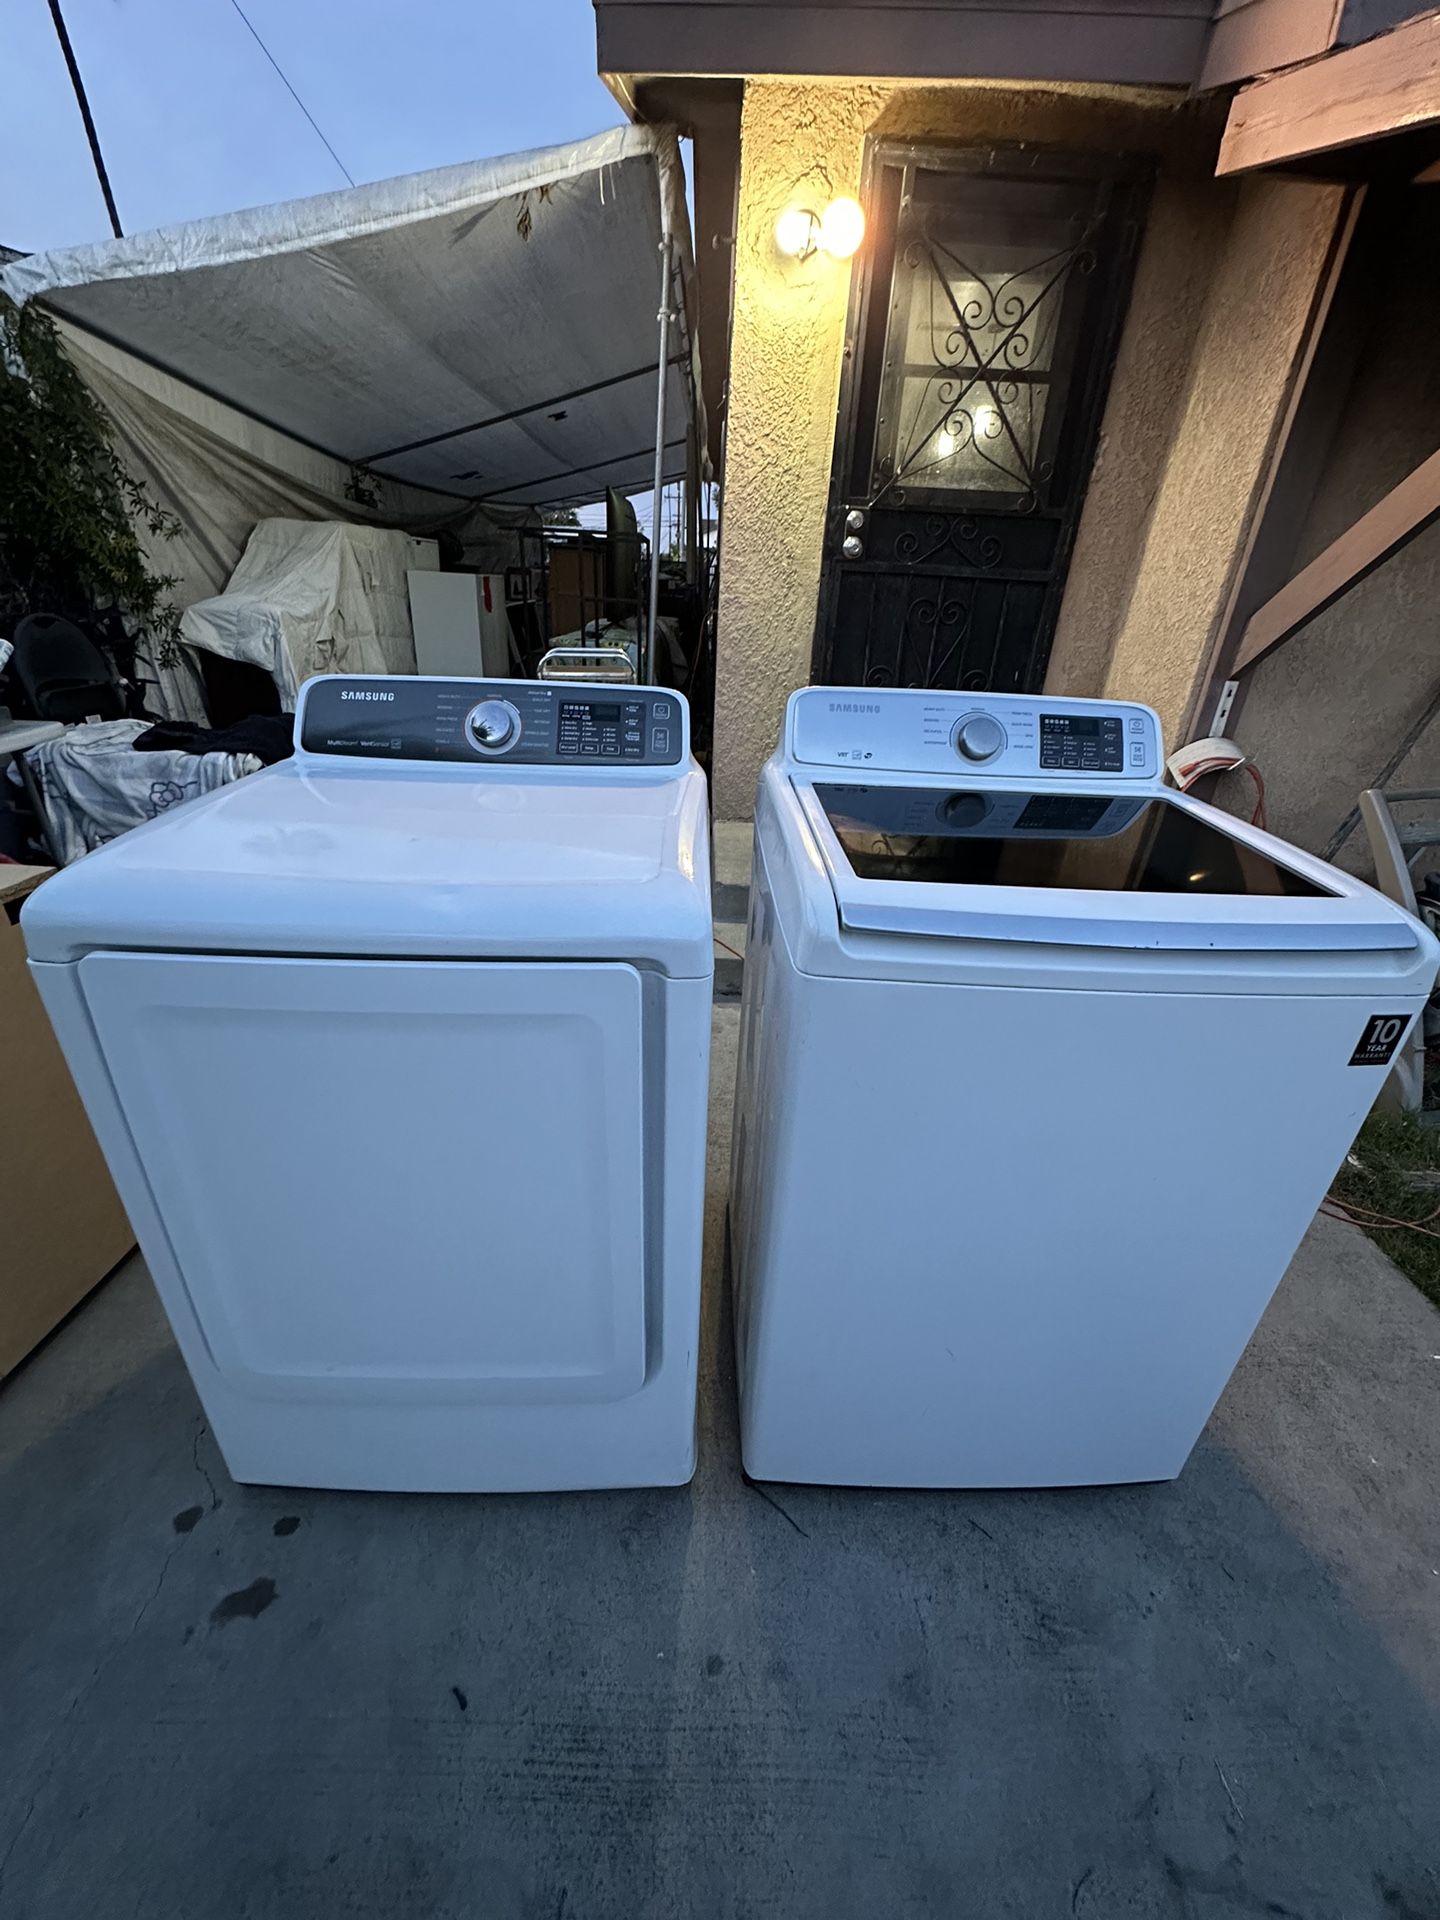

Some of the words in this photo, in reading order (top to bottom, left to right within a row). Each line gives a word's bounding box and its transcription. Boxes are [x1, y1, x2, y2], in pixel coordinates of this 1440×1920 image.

[341, 690, 395, 702] SAMSUNG
[829, 703, 880, 714] SAMSUNG
[1369, 1018, 1401, 1044] 10
[1366, 1044, 1388, 1052] YEAR
